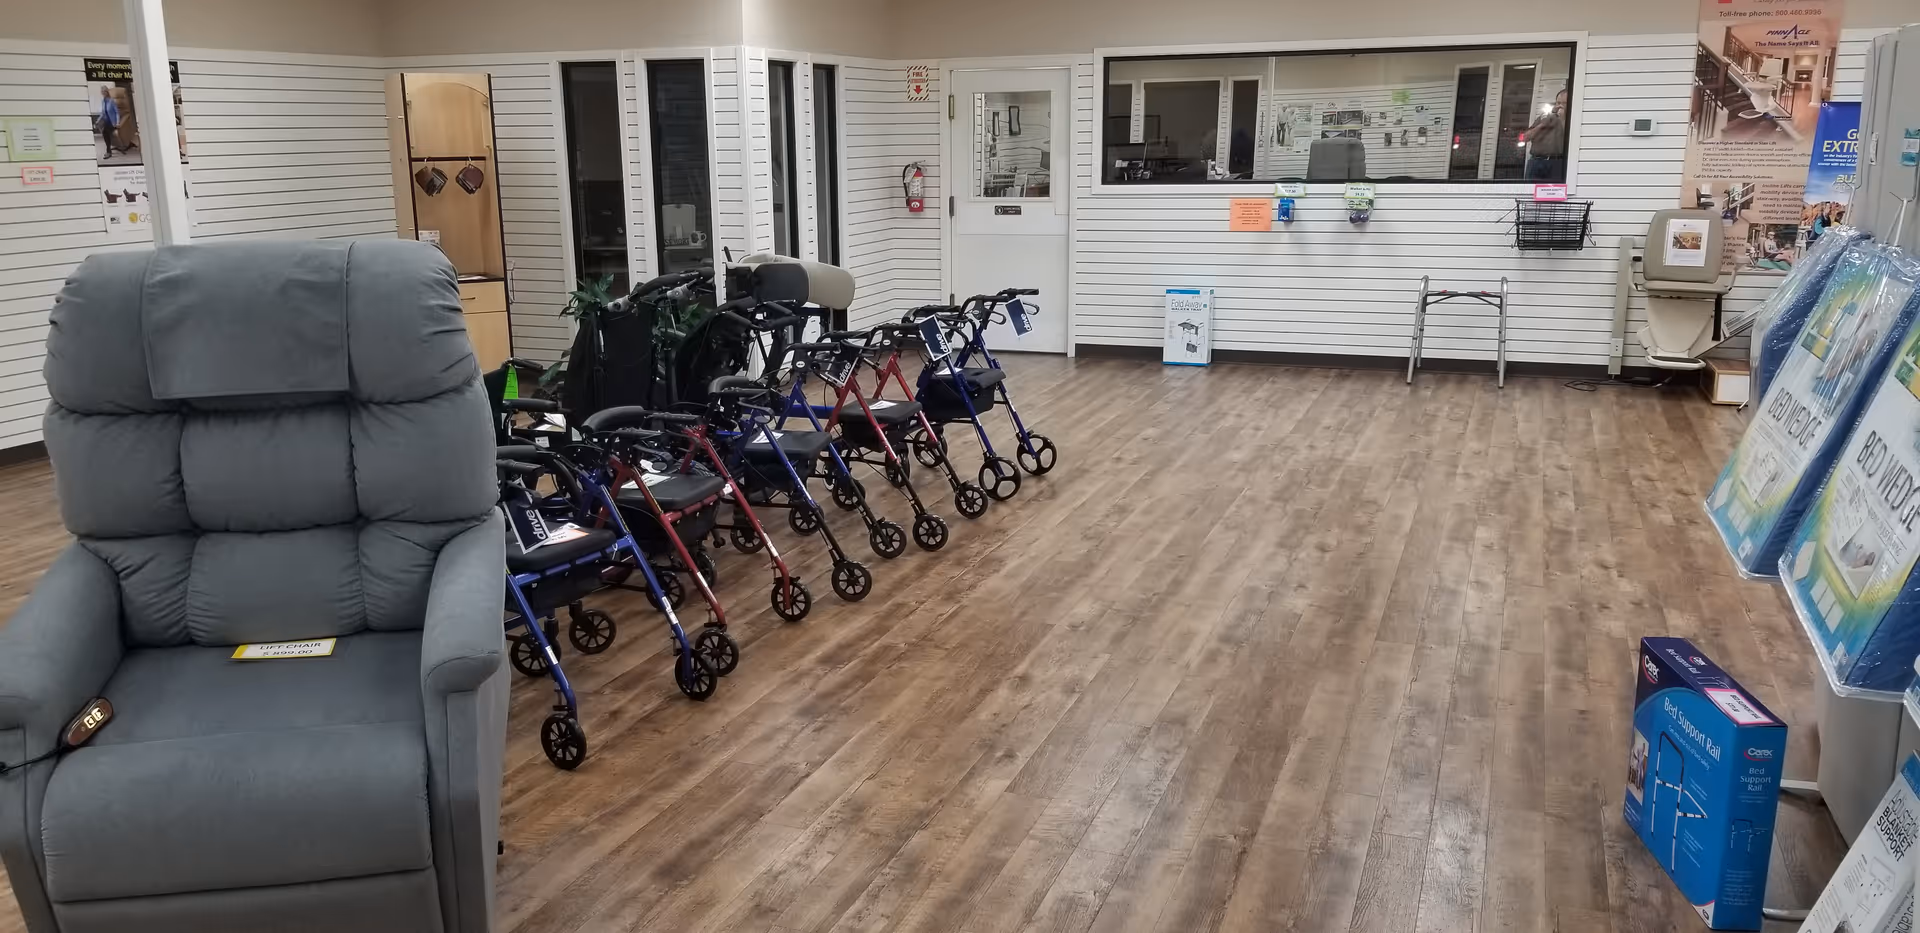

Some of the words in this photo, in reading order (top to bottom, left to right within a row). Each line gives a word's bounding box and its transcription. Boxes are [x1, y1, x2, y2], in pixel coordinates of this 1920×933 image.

[88, 62, 105, 70] Every
[1823, 141, 1858, 152] EXTR
[1171, 299, 1184, 308] Fold
[1185, 300, 1203, 309] Away
[936, 333, 948, 353] drive
[840, 362, 851, 382] drive
[1768, 387, 1792, 422] BED
[1783, 400, 1822, 450] WEDGE
[1857, 430, 1888, 478] BED
[526, 510, 547, 540] drive
[1644, 655, 1660, 679] Carex
[1664, 696, 1678, 719] Bed
[1678, 710, 1706, 747] Support
[1706, 738, 1721, 762] Rail
[1748, 748, 1774, 756] Carex
[1740, 776, 1771, 784] Support
[1876, 815, 1904, 862] SUPPORT
[1882, 806, 1912, 852] BLANKET
